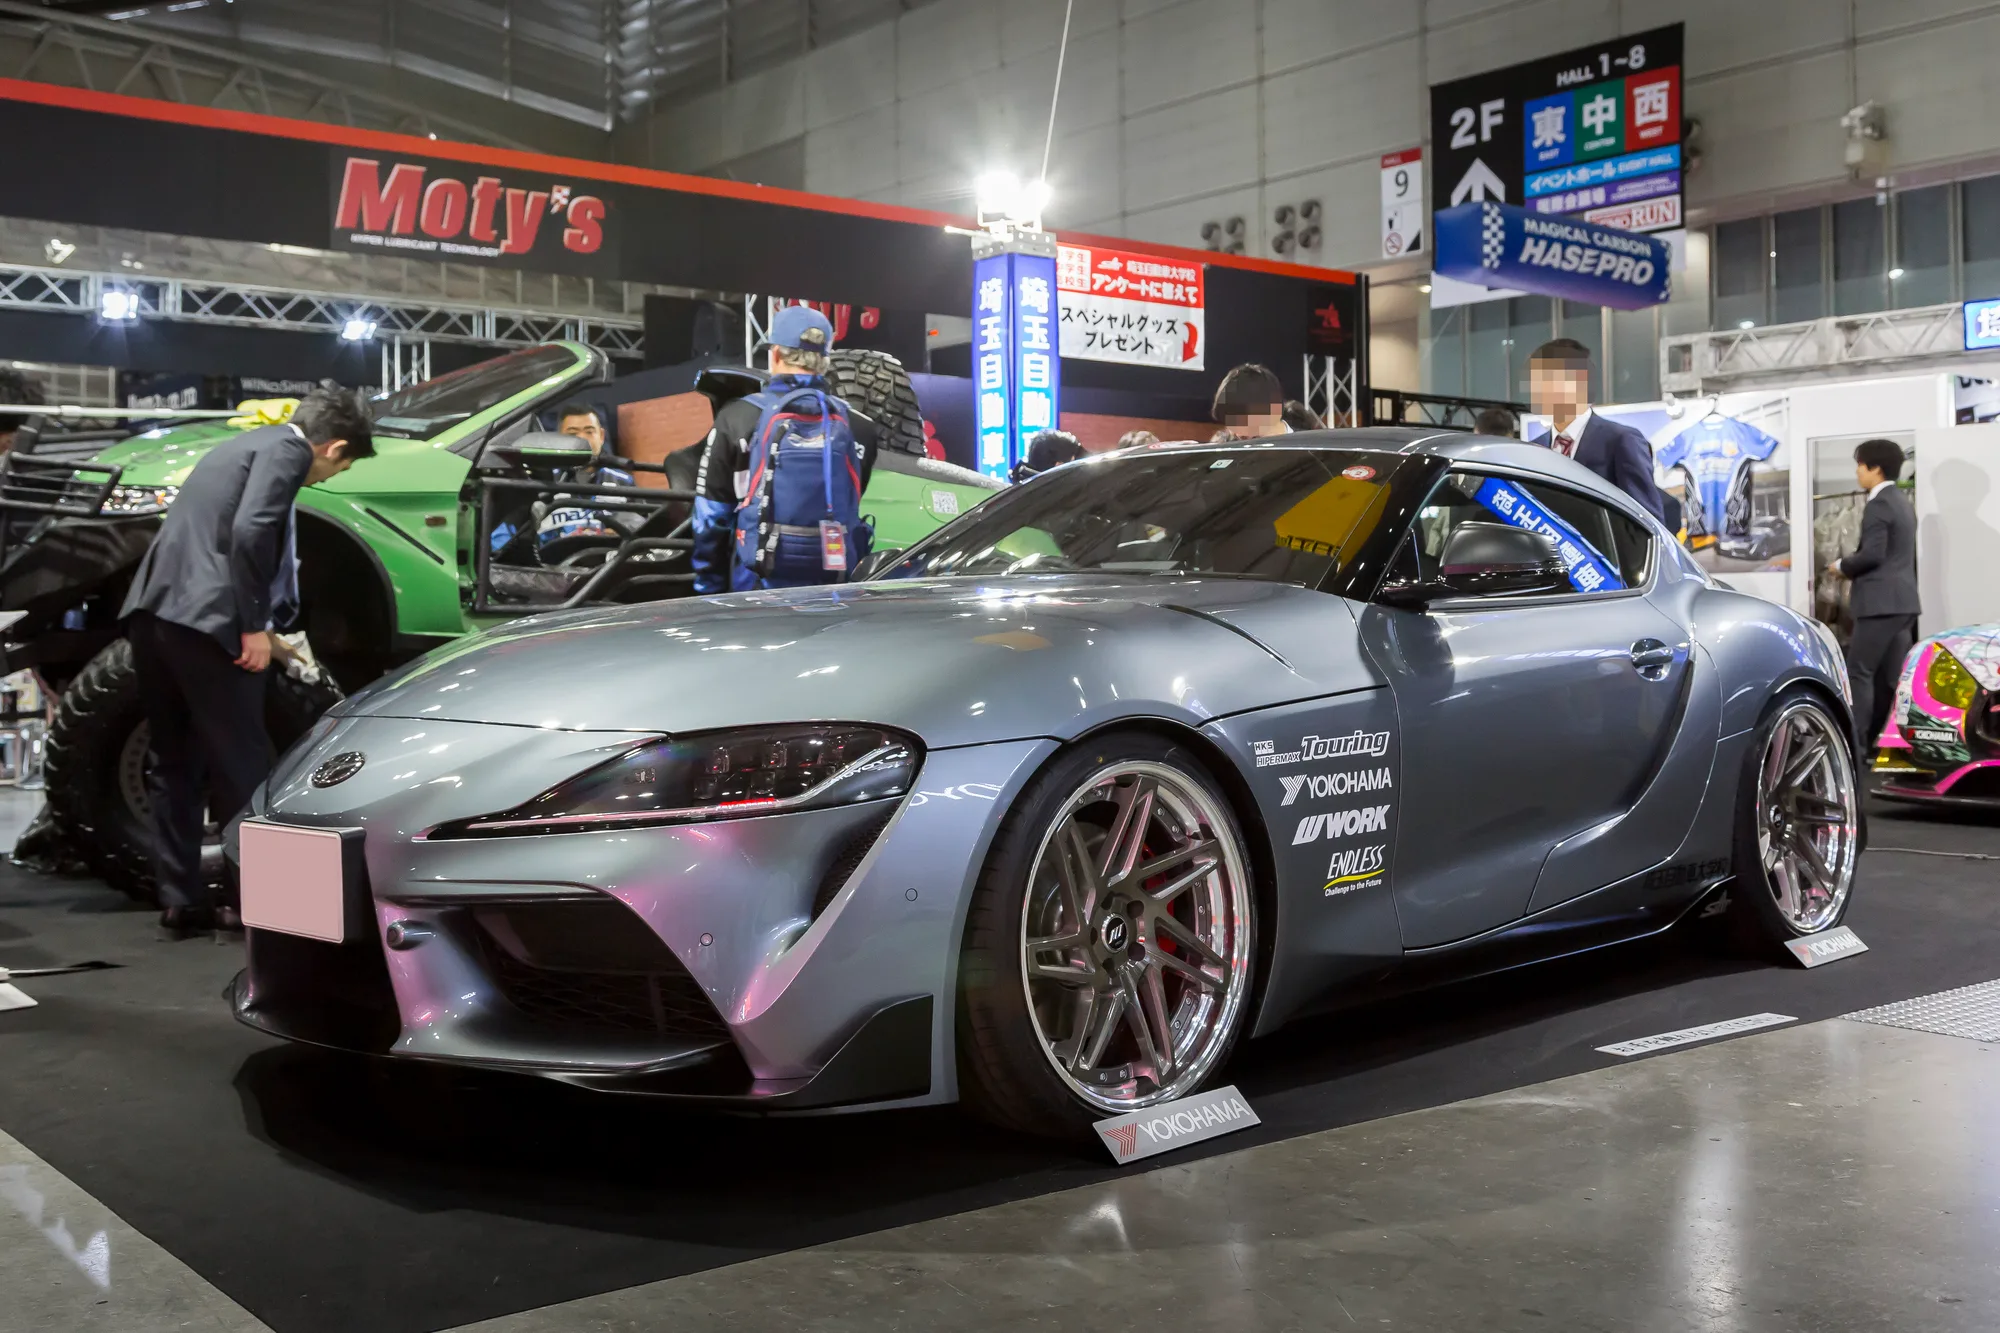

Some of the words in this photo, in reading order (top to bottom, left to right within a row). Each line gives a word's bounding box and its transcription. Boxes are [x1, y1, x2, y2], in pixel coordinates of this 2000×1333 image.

[1556, 65, 1594, 87] HALL
[1582, 93, 1616, 136] 中
[1632, 79, 1670, 127] 西
[1450, 98, 1505, 150] 2F
[1531, 105, 1567, 148] 東
[1395, 168, 1408, 198] 9
[1530, 160, 1616, 192] イベントホール
[335, 157, 606, 254] Moty's
[1631, 200, 1675, 228] RUN
[1524, 217, 1591, 244] MAGICAL
[1592, 231, 1651, 257] CARBON
[1518, 237, 1655, 286] HASEPRO
[1091, 272, 1199, 304] アンケートに答えて
[1061, 307, 1179, 335] スペシャルグッズ
[1085, 331, 1154, 355] プレゼント
[1254, 741, 1273, 752] HKS
[1256, 751, 1301, 767] HIPERMAX
[1301, 729, 1390, 761] Touring
[1306, 767, 1393, 799] YOKOHAMA
[1325, 804, 1391, 840] WORK
[1326, 844, 1386, 880] ENDLESS
[1324, 884, 1350, 897] Challenge
[1350, 882, 1356, 892] to
[1356, 881, 1365, 890] the
[1365, 878, 1382, 888] Future
[1807, 932, 1862, 957] YOKOHAMA
[1138, 1097, 1250, 1143] YOKOHAMA
